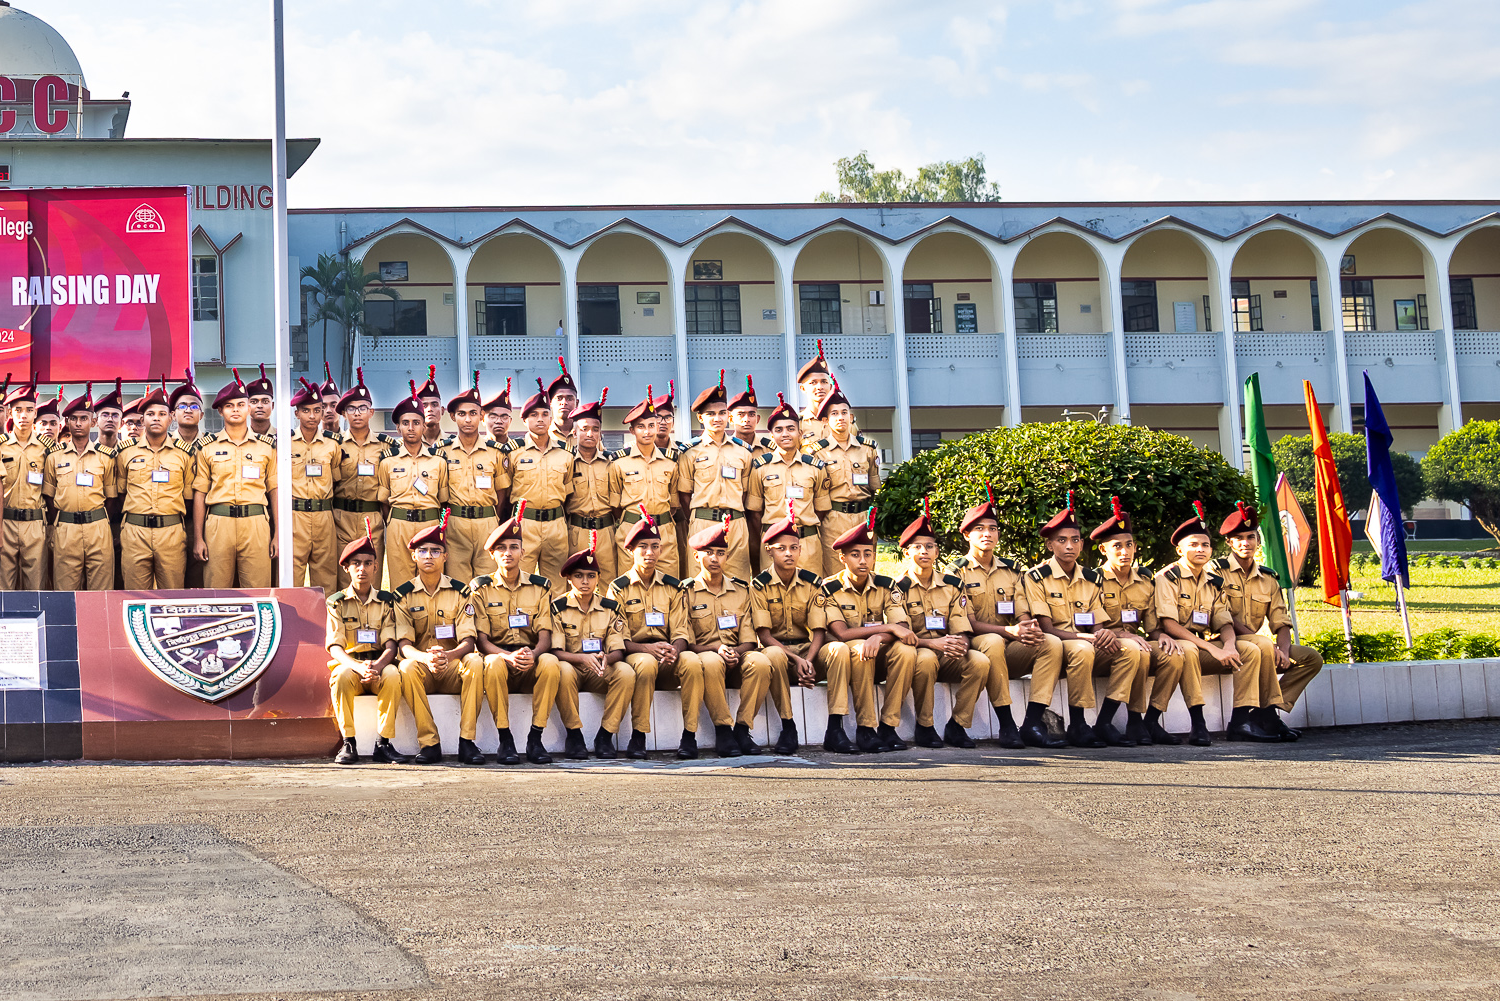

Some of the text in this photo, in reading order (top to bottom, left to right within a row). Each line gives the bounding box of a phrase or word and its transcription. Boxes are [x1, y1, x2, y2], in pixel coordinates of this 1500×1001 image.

[191, 185, 273, 210] ILDING
[11, 273, 160, 306] RAISING DAY
